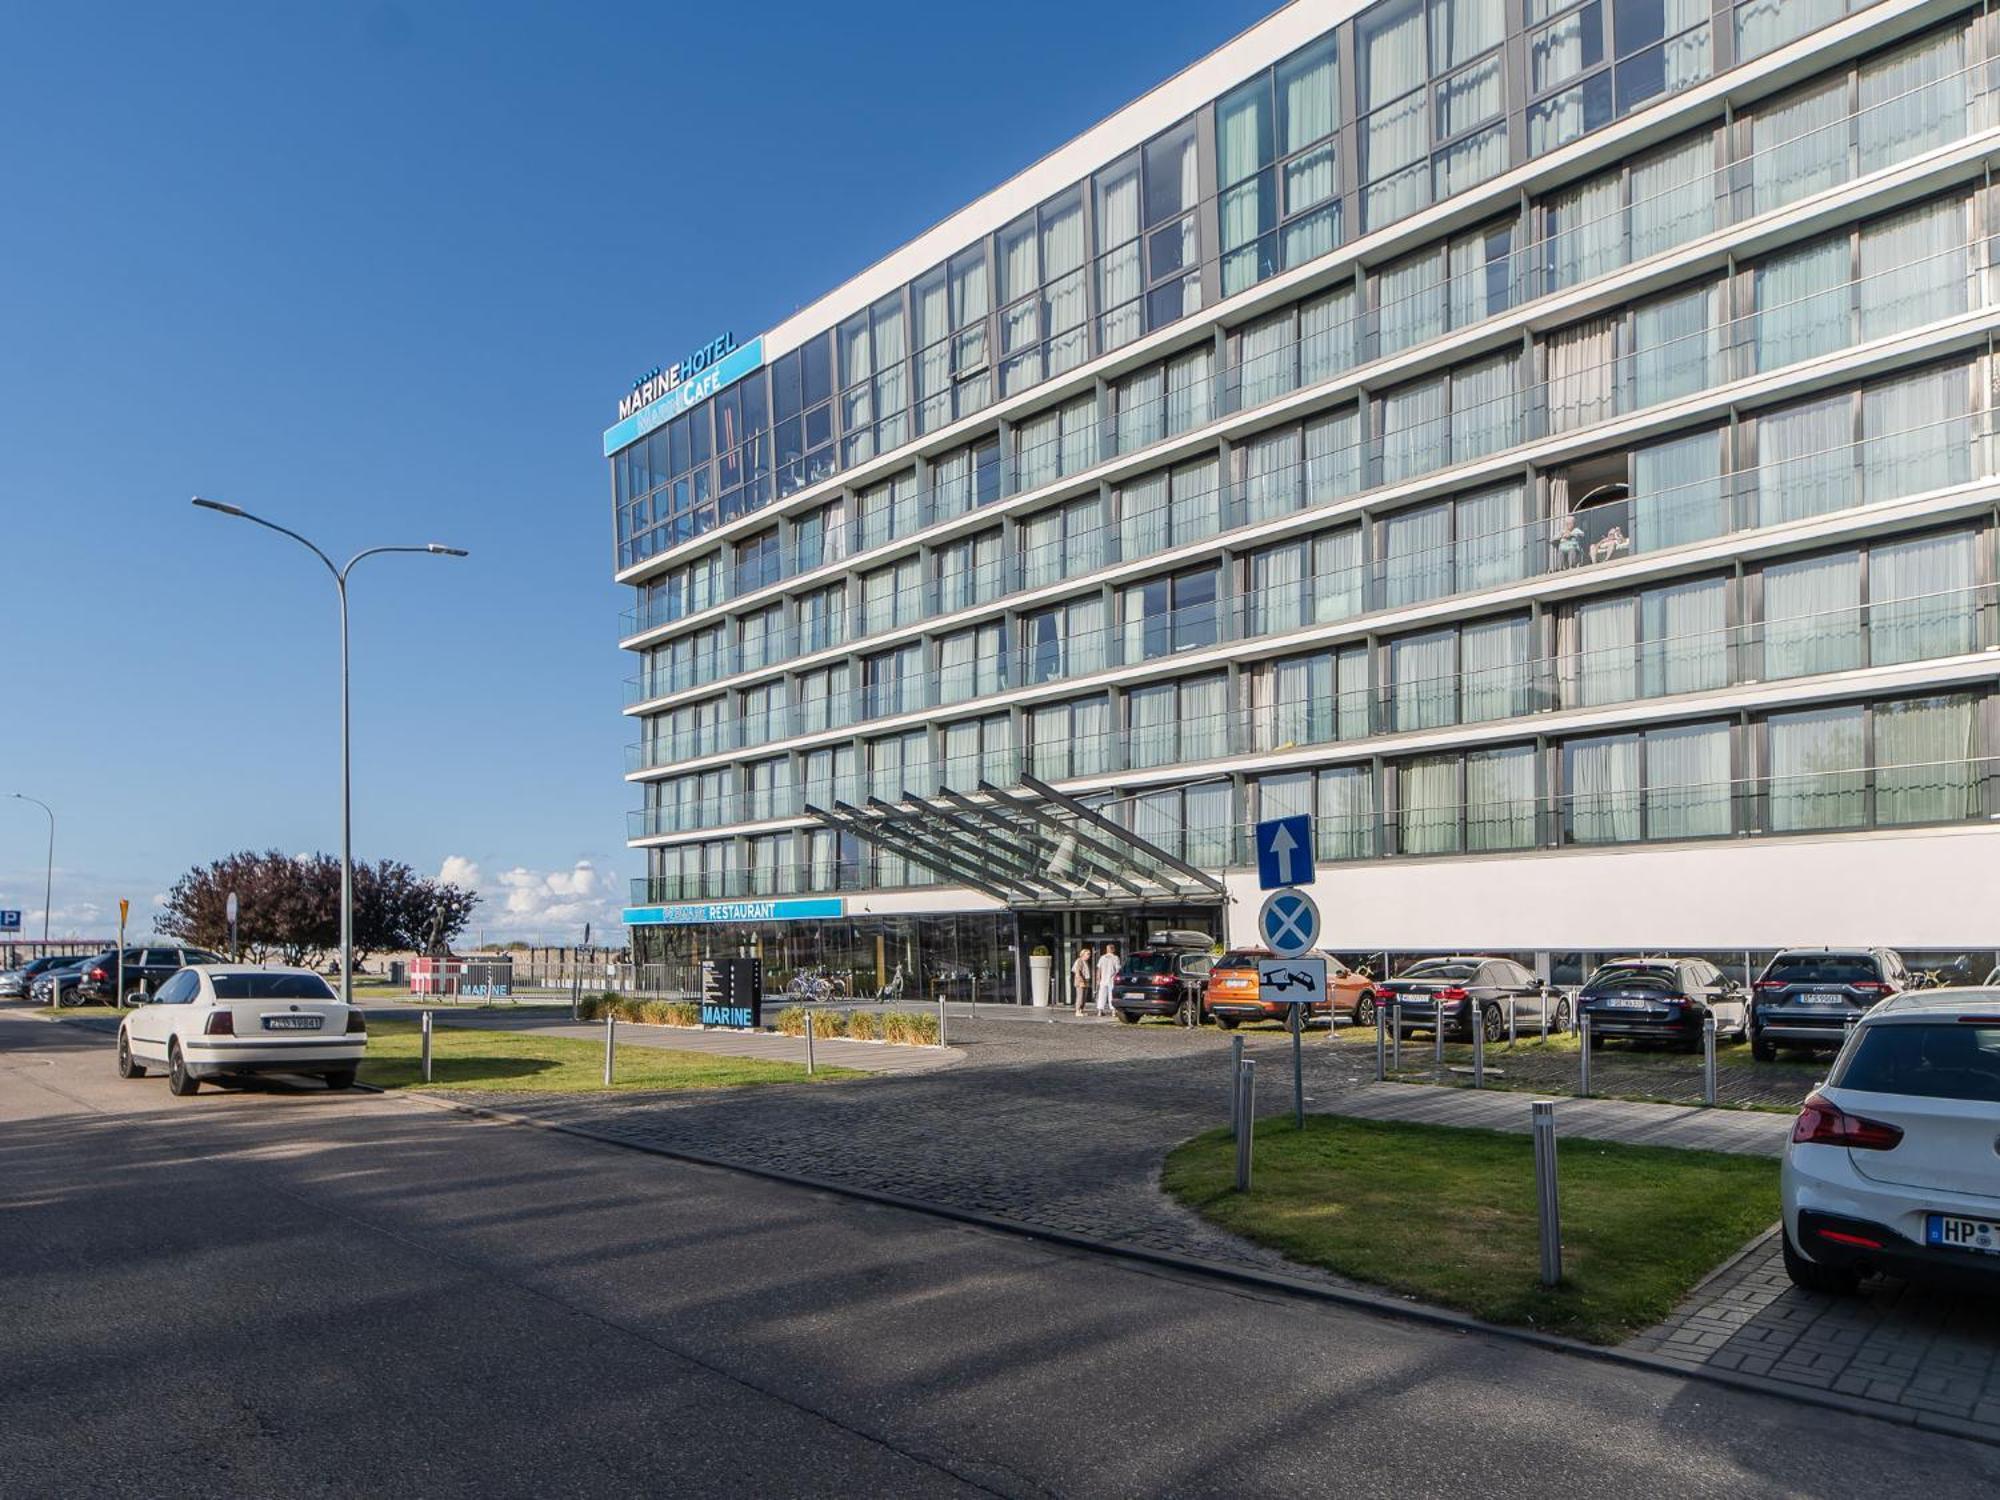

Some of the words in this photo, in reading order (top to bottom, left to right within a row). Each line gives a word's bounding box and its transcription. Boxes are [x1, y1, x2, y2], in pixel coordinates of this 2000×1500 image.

[4, 911, 17, 924] P
[709, 903, 776, 920] RESTAURANT
[462, 984, 508, 996] MARNE
[702, 1006, 753, 1026] MARINE
[1945, 1220, 1975, 1243] HP
